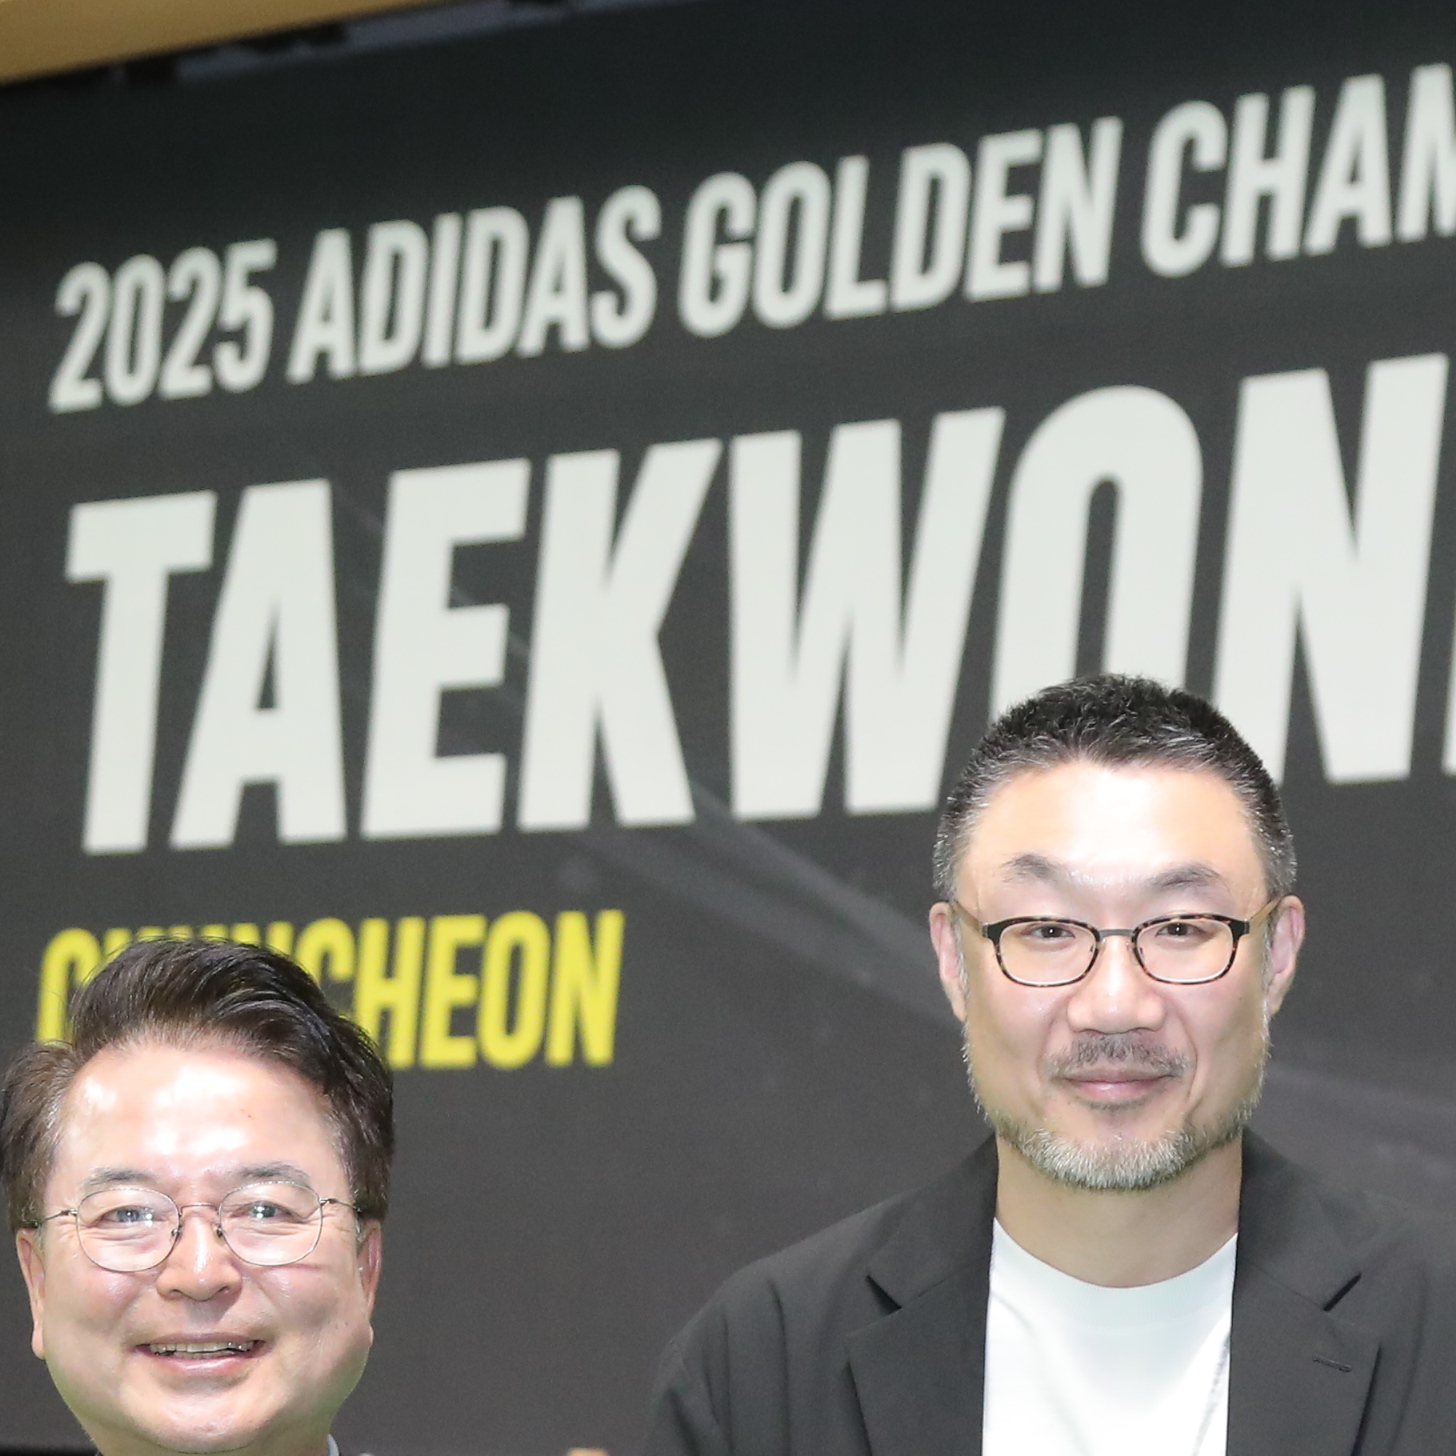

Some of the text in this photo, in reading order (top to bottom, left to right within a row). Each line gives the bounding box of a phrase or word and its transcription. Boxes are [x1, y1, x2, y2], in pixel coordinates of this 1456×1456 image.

[49, 240, 276, 412] 2025
[286, 186, 661, 385] ADIDAS
[678, 117, 1122, 337] GOLDEN
